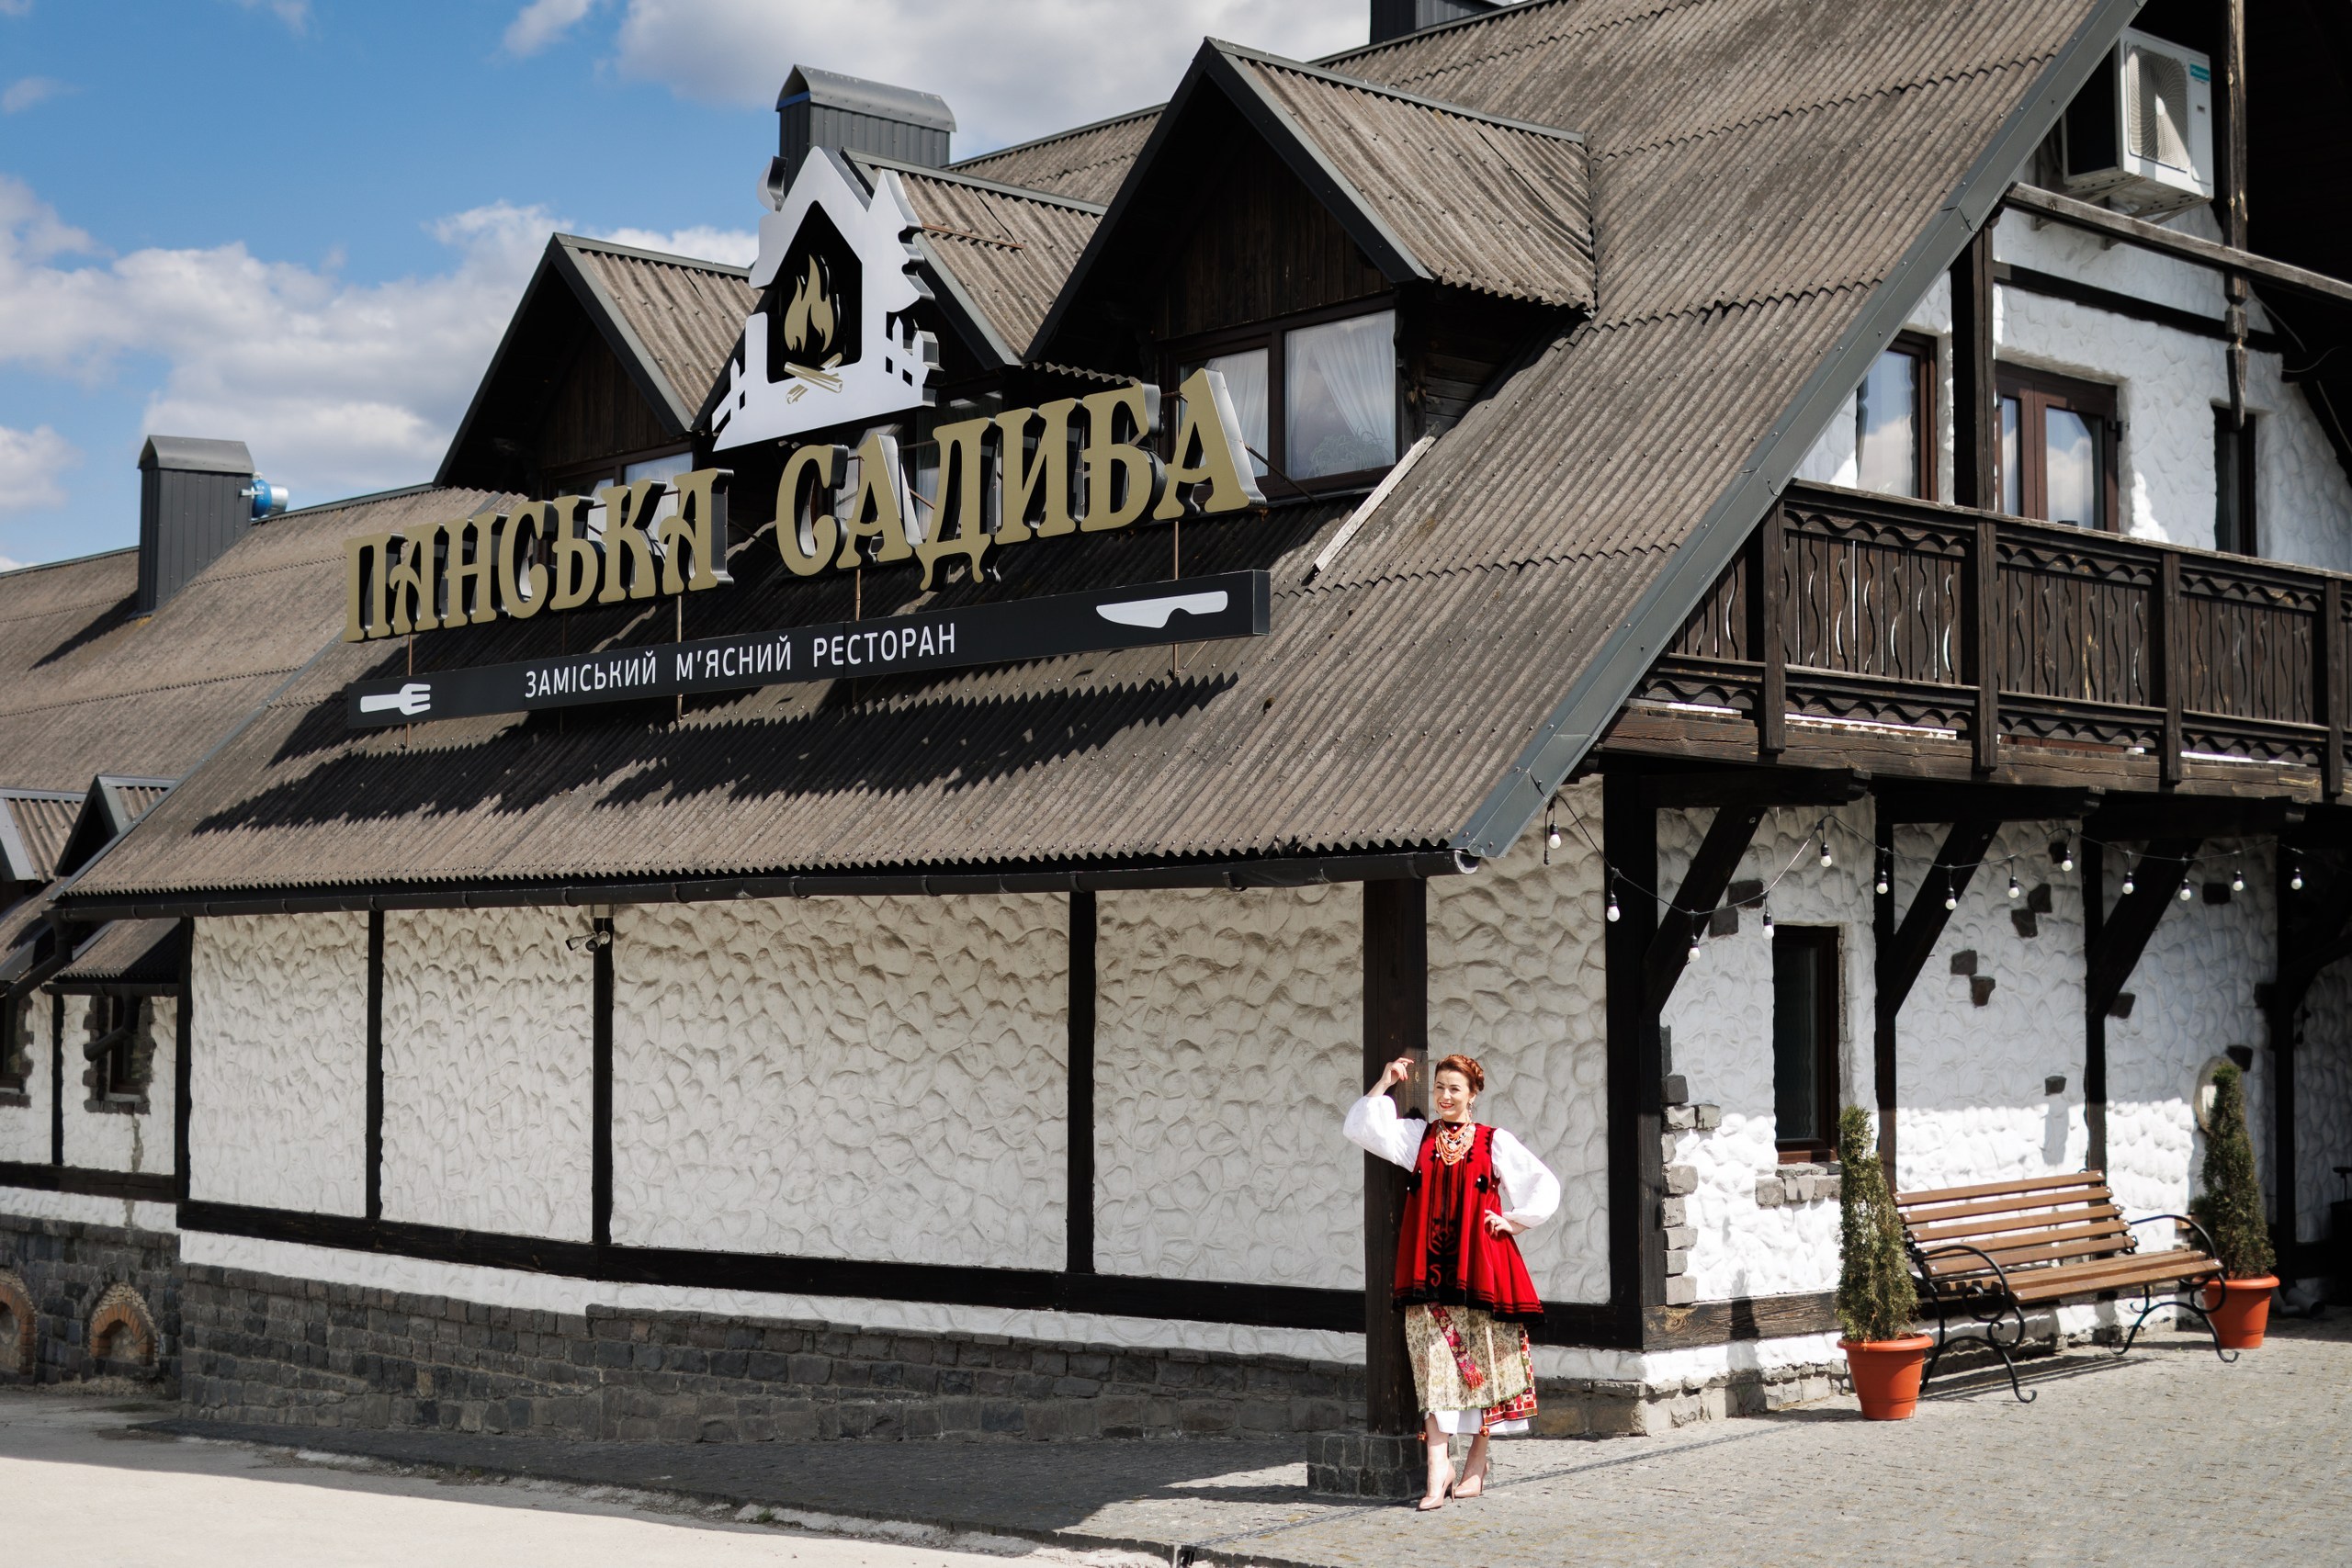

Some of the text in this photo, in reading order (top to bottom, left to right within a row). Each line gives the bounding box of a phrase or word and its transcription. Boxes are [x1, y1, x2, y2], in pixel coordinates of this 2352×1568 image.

[343, 367, 1252, 643] ПАНСЬКА САДИБА
[525, 622, 956, 698] ЗАМІСЬКИЙ М'ЯСНИЙ РЕСТОРАН
